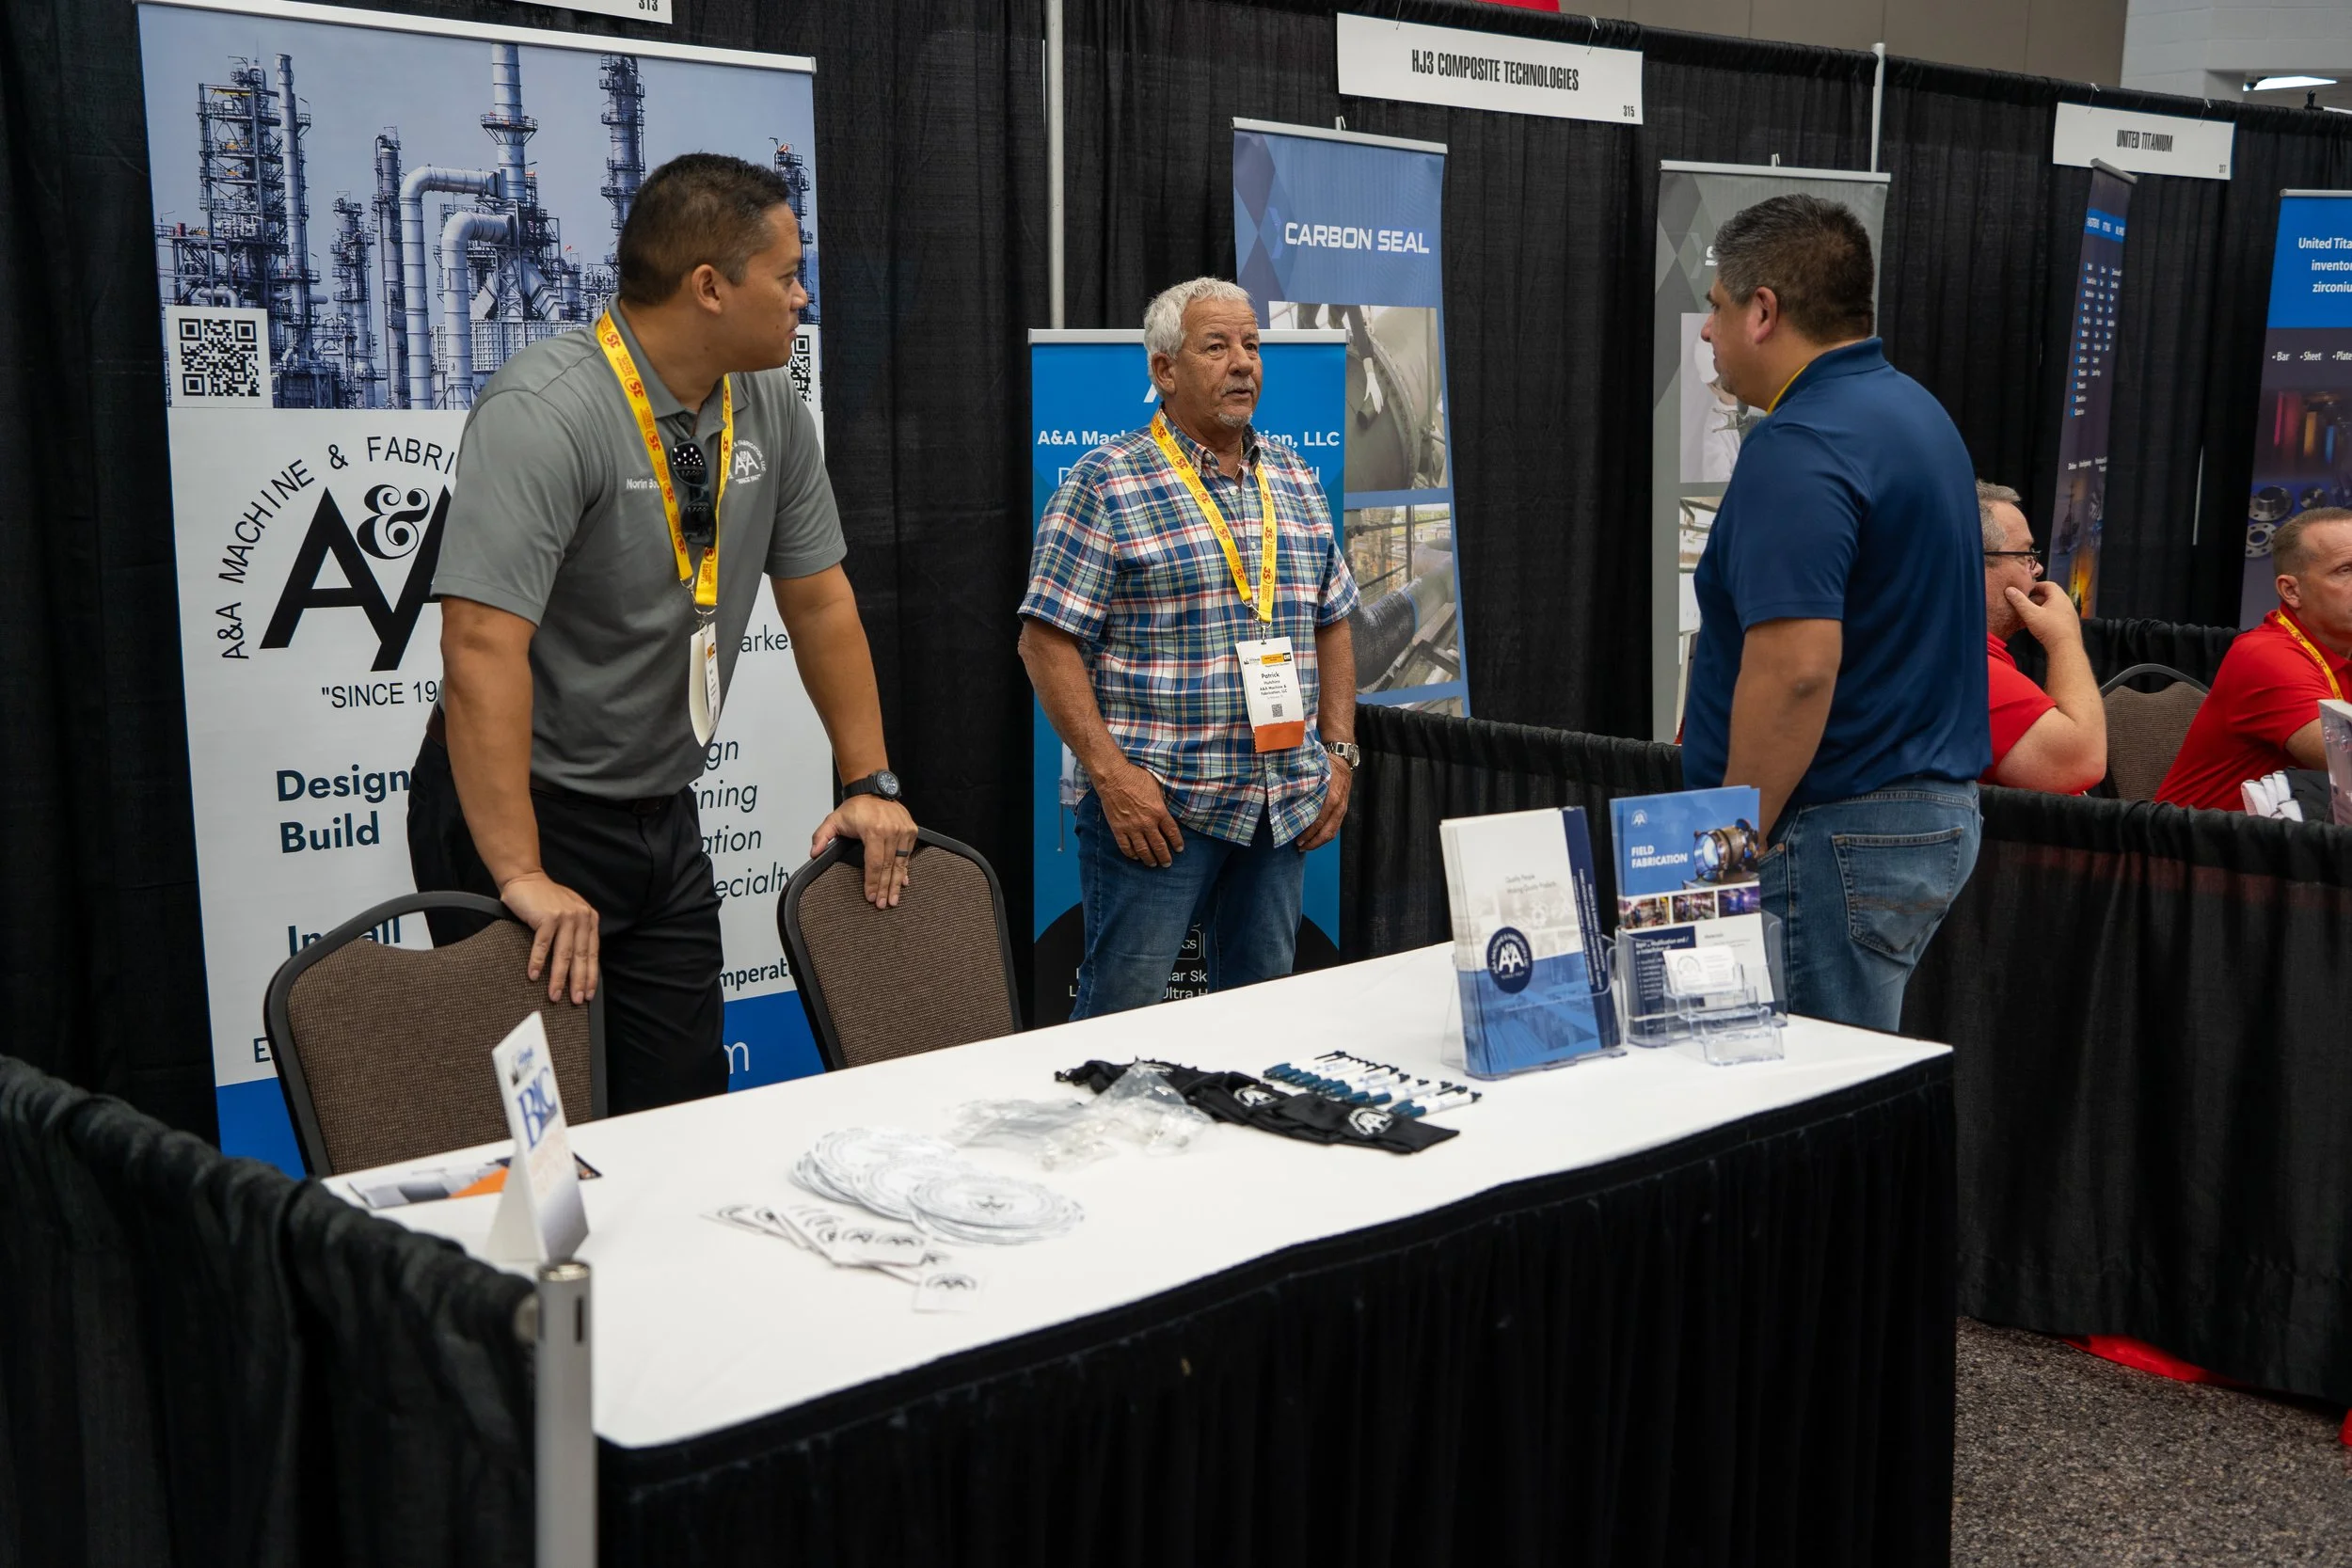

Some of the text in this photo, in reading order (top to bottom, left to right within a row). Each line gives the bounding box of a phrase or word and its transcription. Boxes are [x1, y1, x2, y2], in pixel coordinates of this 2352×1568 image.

[1411, 49, 1580, 91] HJ3 COMPOSITE TECHNOLOGIES
[1623, 104, 1635, 118] 315
[2117, 130, 2173, 152] UNITED TITANIUM
[1285, 222, 1430, 254] CARBON SEAL
[2298, 237, 2332, 249] United
[1037, 430, 1077, 446] A&A
[1304, 431, 1340, 447] LLC
[328, 444, 349, 470] &
[218, 459, 315, 584] MACHINE
[215, 602, 249, 659] A&A
[321, 680, 439, 708] "SINCE 19
[276, 764, 411, 804] Design
[280, 811, 381, 854] Build
[1631, 846, 1655, 857] FIELD
[1631, 853, 1689, 868] FABRICATION
